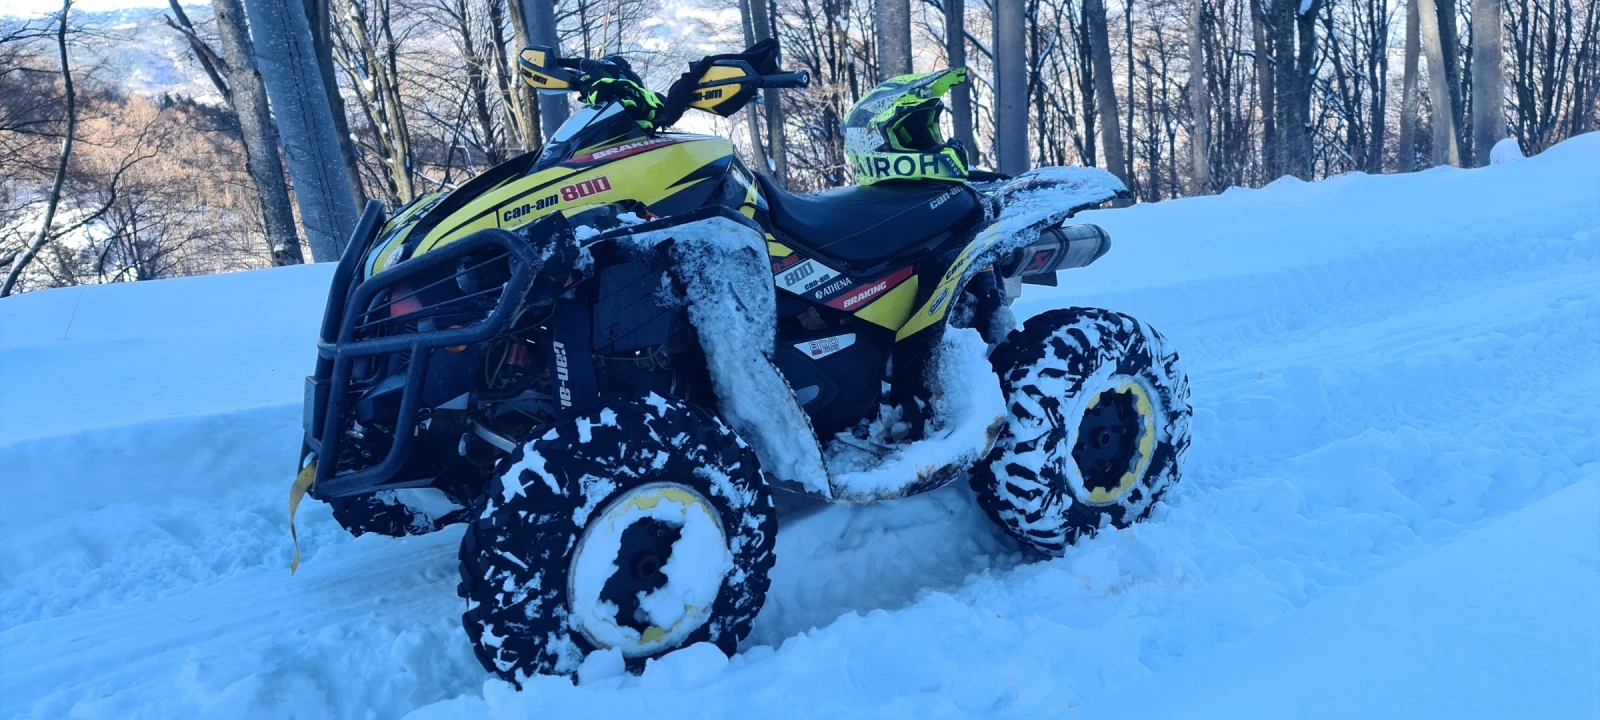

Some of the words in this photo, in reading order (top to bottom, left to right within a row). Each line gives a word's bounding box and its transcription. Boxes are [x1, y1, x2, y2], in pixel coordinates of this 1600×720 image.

[521, 67, 548, 85] can-am
[692, 88, 723, 101] n-am
[592, 138, 673, 160] BRAKING
[856, 154, 940, 177] AIROH
[503, 193, 559, 222] can-am
[560, 175, 613, 203] 800
[772, 254, 799, 273] n-am
[784, 261, 815, 287] 800
[804, 273, 831, 291] can-am
[823, 277, 853, 297] ATHENA
[843, 281, 887, 308] BRAKING
